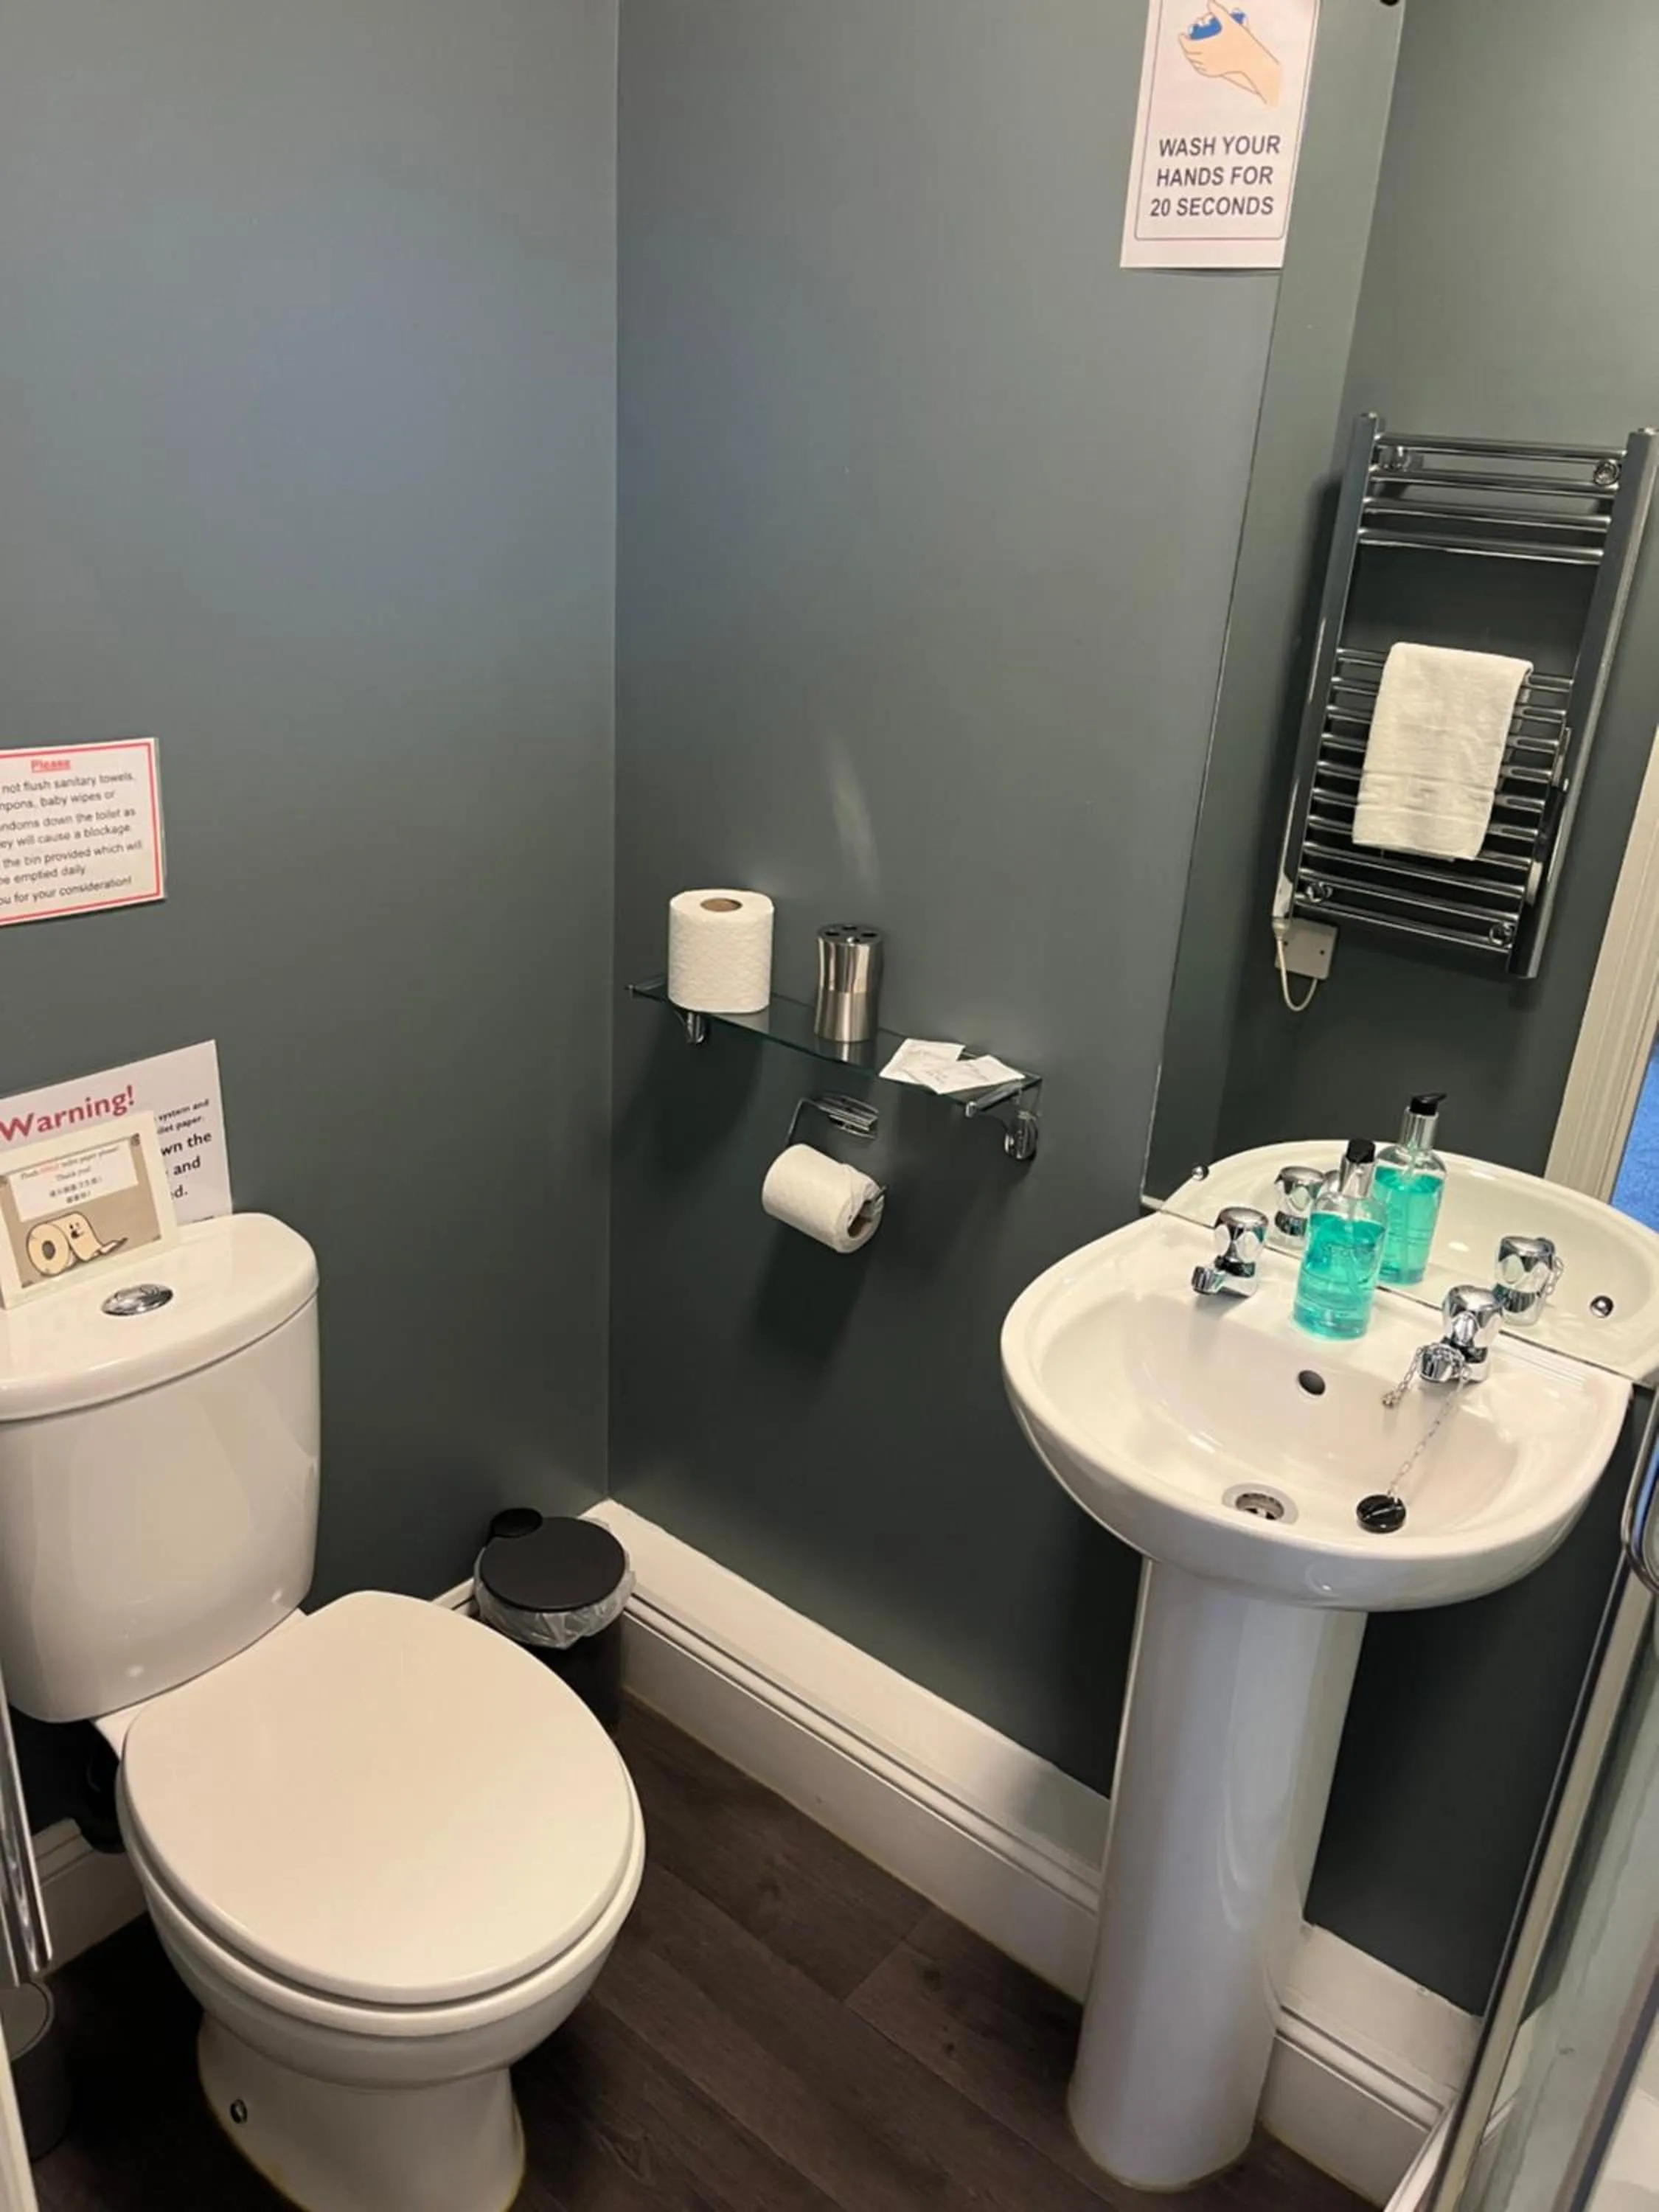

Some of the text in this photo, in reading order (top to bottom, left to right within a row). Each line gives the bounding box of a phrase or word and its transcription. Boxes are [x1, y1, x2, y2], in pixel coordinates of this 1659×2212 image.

[1159, 135, 1281, 158] WASH YOUR
[1156, 166, 1273, 187] HANDS FOR
[1150, 196, 1274, 217] 20 SECONDS
[31, 759, 71, 773] Please
[2, 783, 21, 793] not
[23, 780, 51, 791] flush
[54, 776, 96, 789] sanitary
[40, 795, 67, 807] baby
[71, 792, 101, 803] wipes
[104, 790, 115, 800] or
[43, 815, 73, 827] down
[76, 813, 93, 823] the
[95, 809, 121, 821] toilet
[124, 808, 136, 817] as
[16, 835, 35, 846] will
[38, 832, 71, 844] cause
[74, 830, 81, 839] a
[2, 839, 142, 868] the bin provided which will
[13, 868, 58, 884] emptied
[14, 891, 29, 902] for
[32, 888, 56, 902] your
[59, 876, 132, 897] consideration!
[0, 1085, 134, 1141] Warning!
[159, 1099, 210, 1121] system and
[187, 1133, 212, 1148] the
[173, 1155, 201, 1176] and
